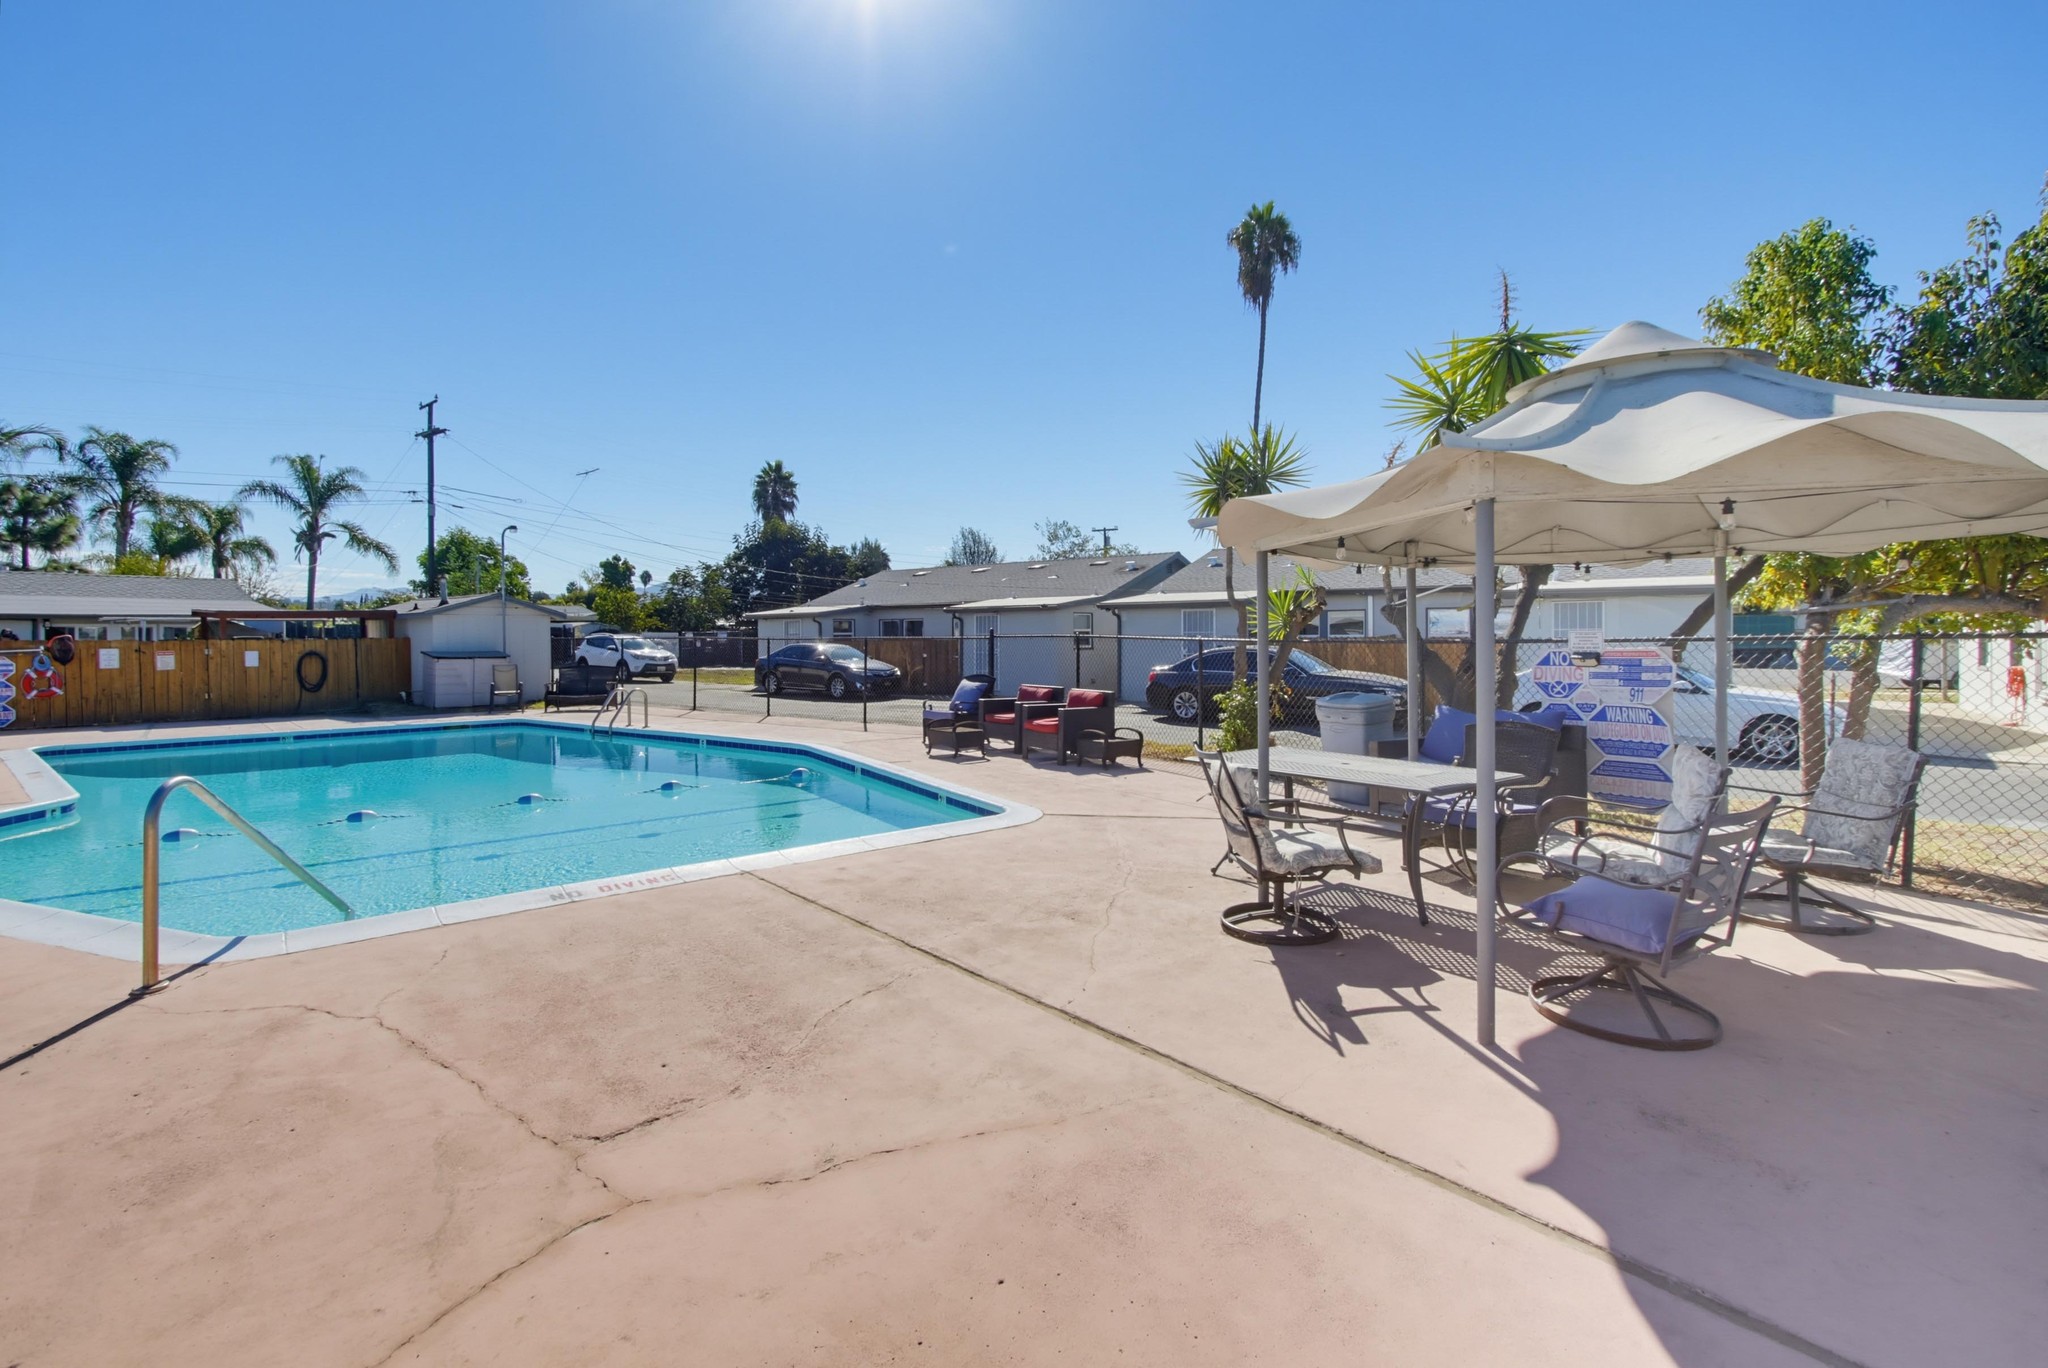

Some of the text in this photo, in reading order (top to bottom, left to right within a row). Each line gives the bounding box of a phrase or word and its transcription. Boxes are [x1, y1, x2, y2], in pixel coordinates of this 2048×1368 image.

[1549, 652, 1569, 666] NO
[1534, 666, 1584, 681] DIVING
[1629, 688, 1644, 702] 911
[1605, 706, 1653, 724] WARNING
[1601, 723, 1639, 738] LIFEGUARD
[1641, 725, 1651, 740] ON
[548, 874, 676, 902] NO DIVING
